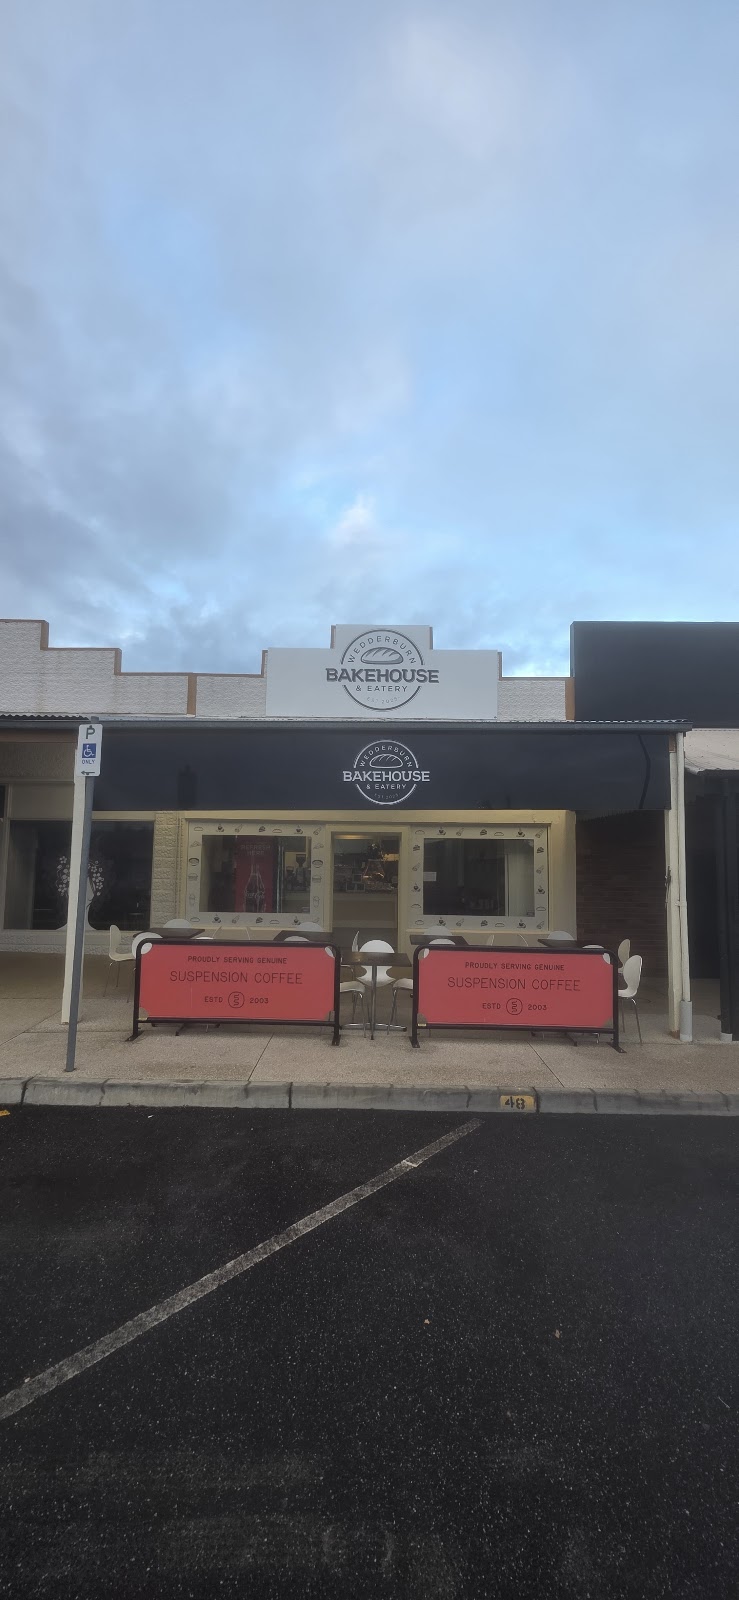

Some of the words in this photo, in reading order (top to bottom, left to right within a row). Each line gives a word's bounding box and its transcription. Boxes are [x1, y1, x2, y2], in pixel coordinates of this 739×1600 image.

[348, 636, 416, 664] WEDDERBURN
[326, 668, 439, 683] BAKEHOUSE
[86, 725, 95, 739] P
[360, 745, 413, 767] WEDDERBURN
[343, 771, 430, 781] BAKEHOUSE
[223, 956, 254, 964] SERVING
[257, 957, 288, 965] GENUINE
[465, 961, 498, 970] PROUDLY
[500, 963, 532, 971] SERVING
[534, 964, 565, 972] GENUINE
[169, 970, 248, 983] SUSPENSION
[254, 972, 303, 985] COFFEE
[447, 976, 526, 990] SUSPENSION
[531, 979, 581, 992] COFFEE
[204, 996, 223, 1004] ESTD
[482, 1002, 501, 1010] ESTD
[527, 1003, 547, 1011] 2003
[505, 1096, 525, 1109] 48
